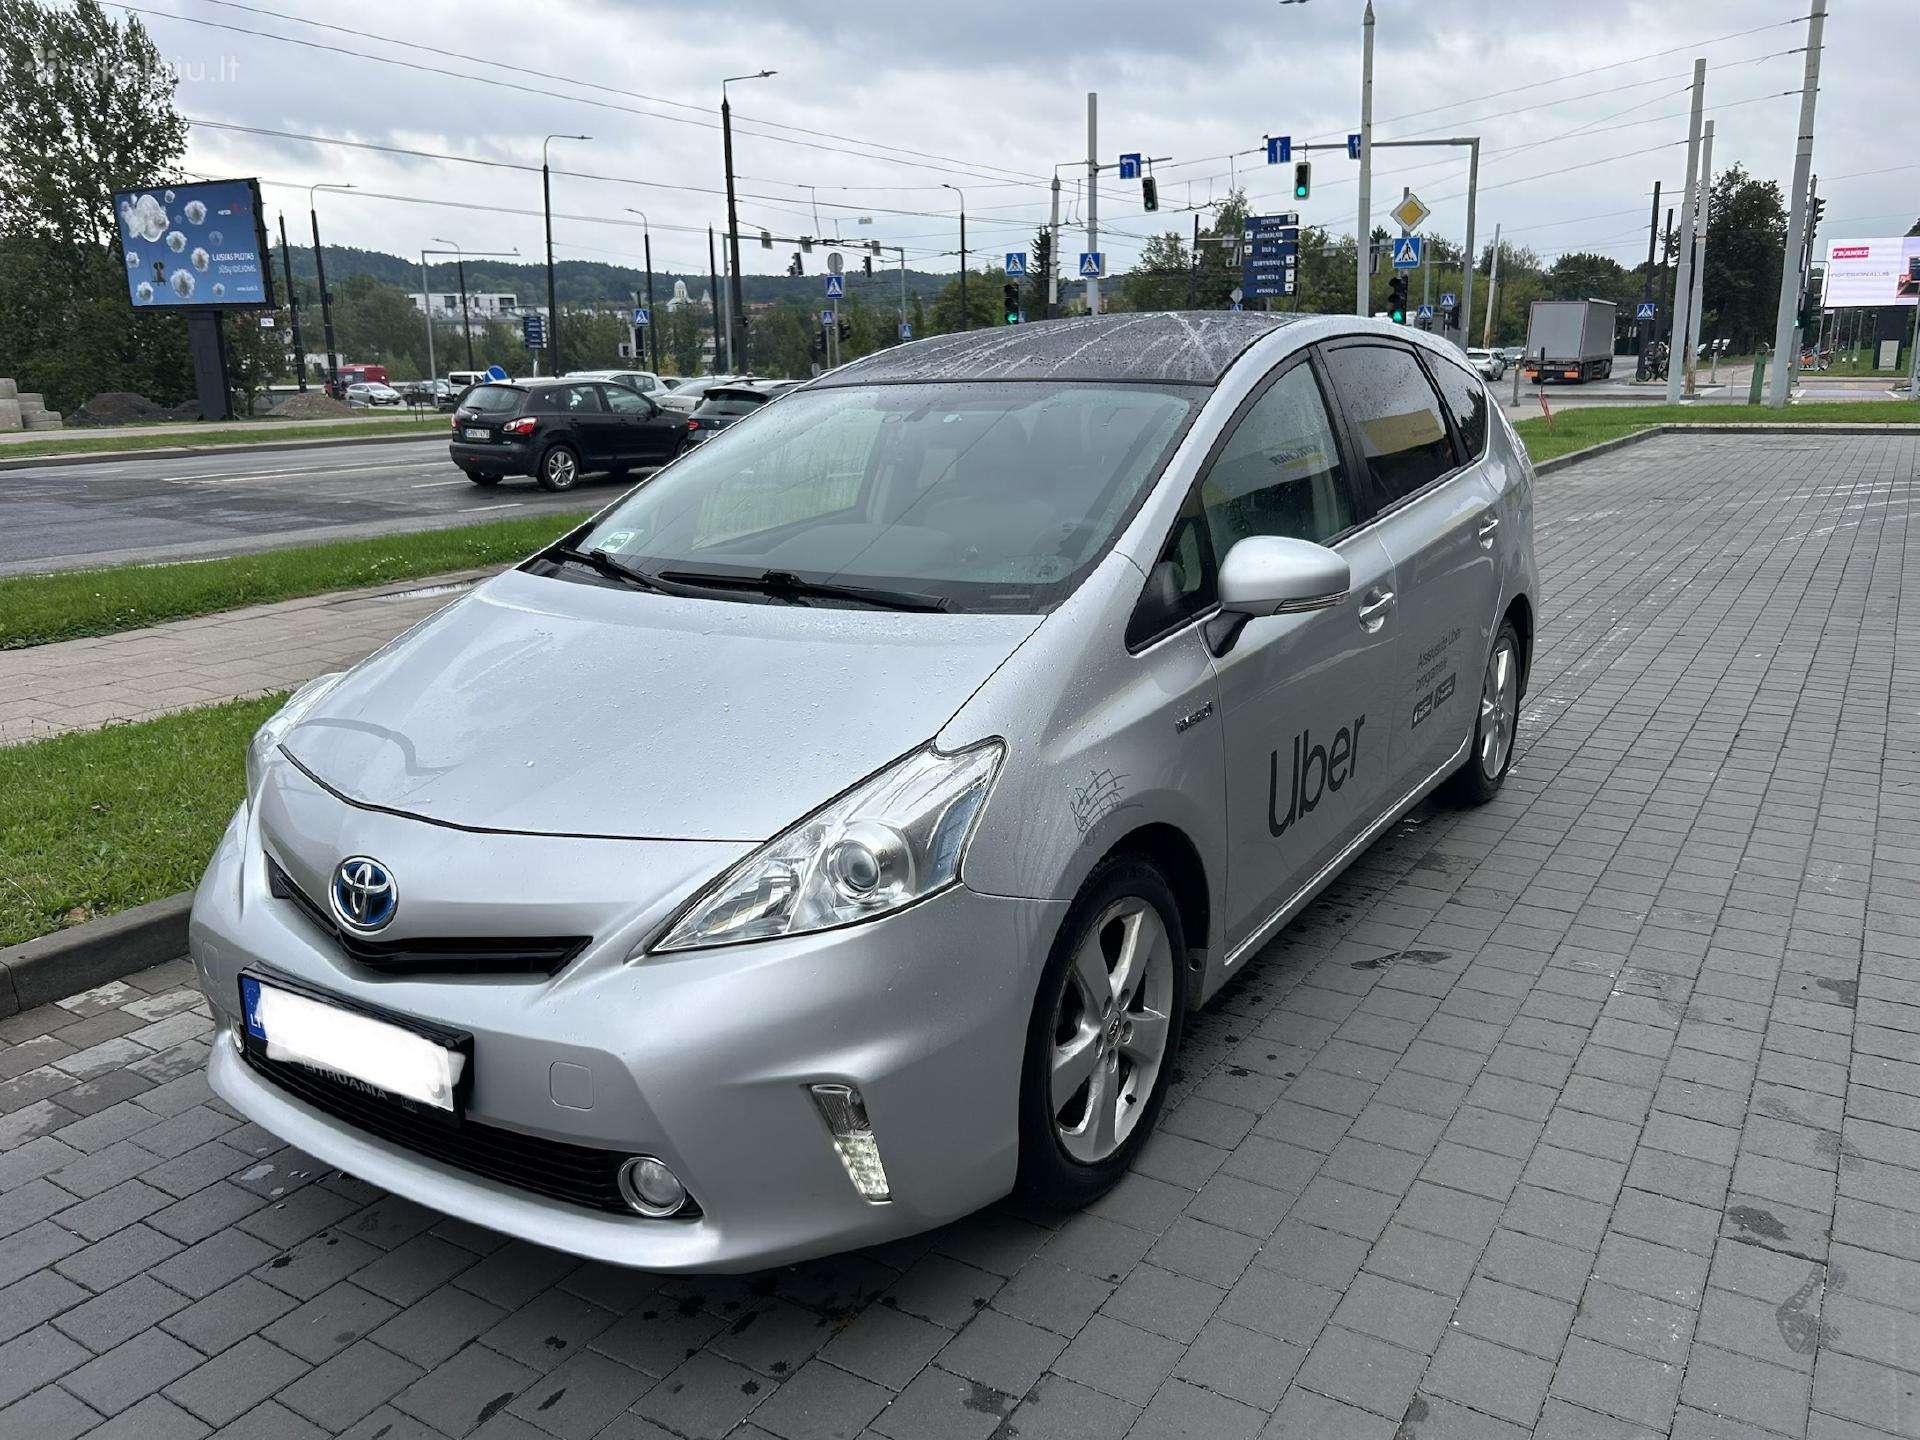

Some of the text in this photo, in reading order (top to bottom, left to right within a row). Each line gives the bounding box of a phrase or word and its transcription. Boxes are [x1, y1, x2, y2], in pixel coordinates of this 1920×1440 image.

[1832, 249, 1869, 258] FRANKE
[1268, 713, 1366, 837] Uber
[302, 1060, 389, 1100] LITHUANIA
